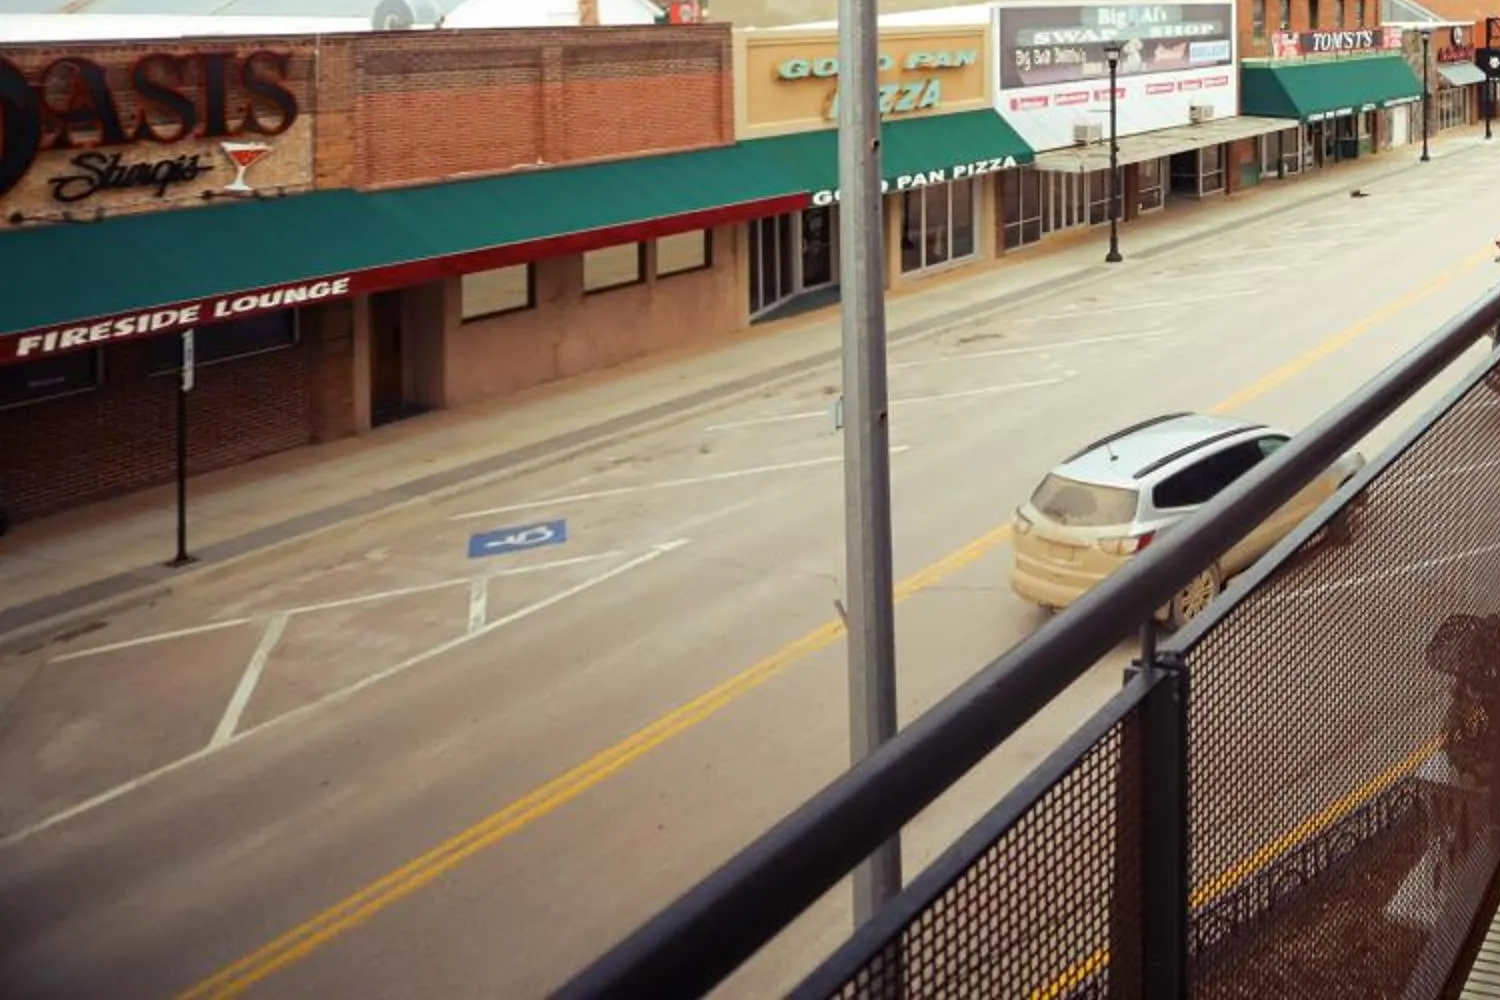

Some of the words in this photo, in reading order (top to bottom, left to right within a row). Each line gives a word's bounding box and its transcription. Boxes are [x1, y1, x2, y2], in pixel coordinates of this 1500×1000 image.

[1033, 28, 1118, 46] SWAP
[1149, 22, 1215, 38] SHOP
[1098, 7, 1127, 28] Big
[779, 56, 894, 79] GOD
[905, 51, 977, 69] PAN
[829, 79, 941, 119] ZZA
[48, 152, 214, 202] Sturgis
[897, 169, 945, 190] PAN
[953, 155, 1017, 180] PIZZA
[16, 304, 201, 357] FIRESIDE
[214, 277, 350, 318] LOUNGE
